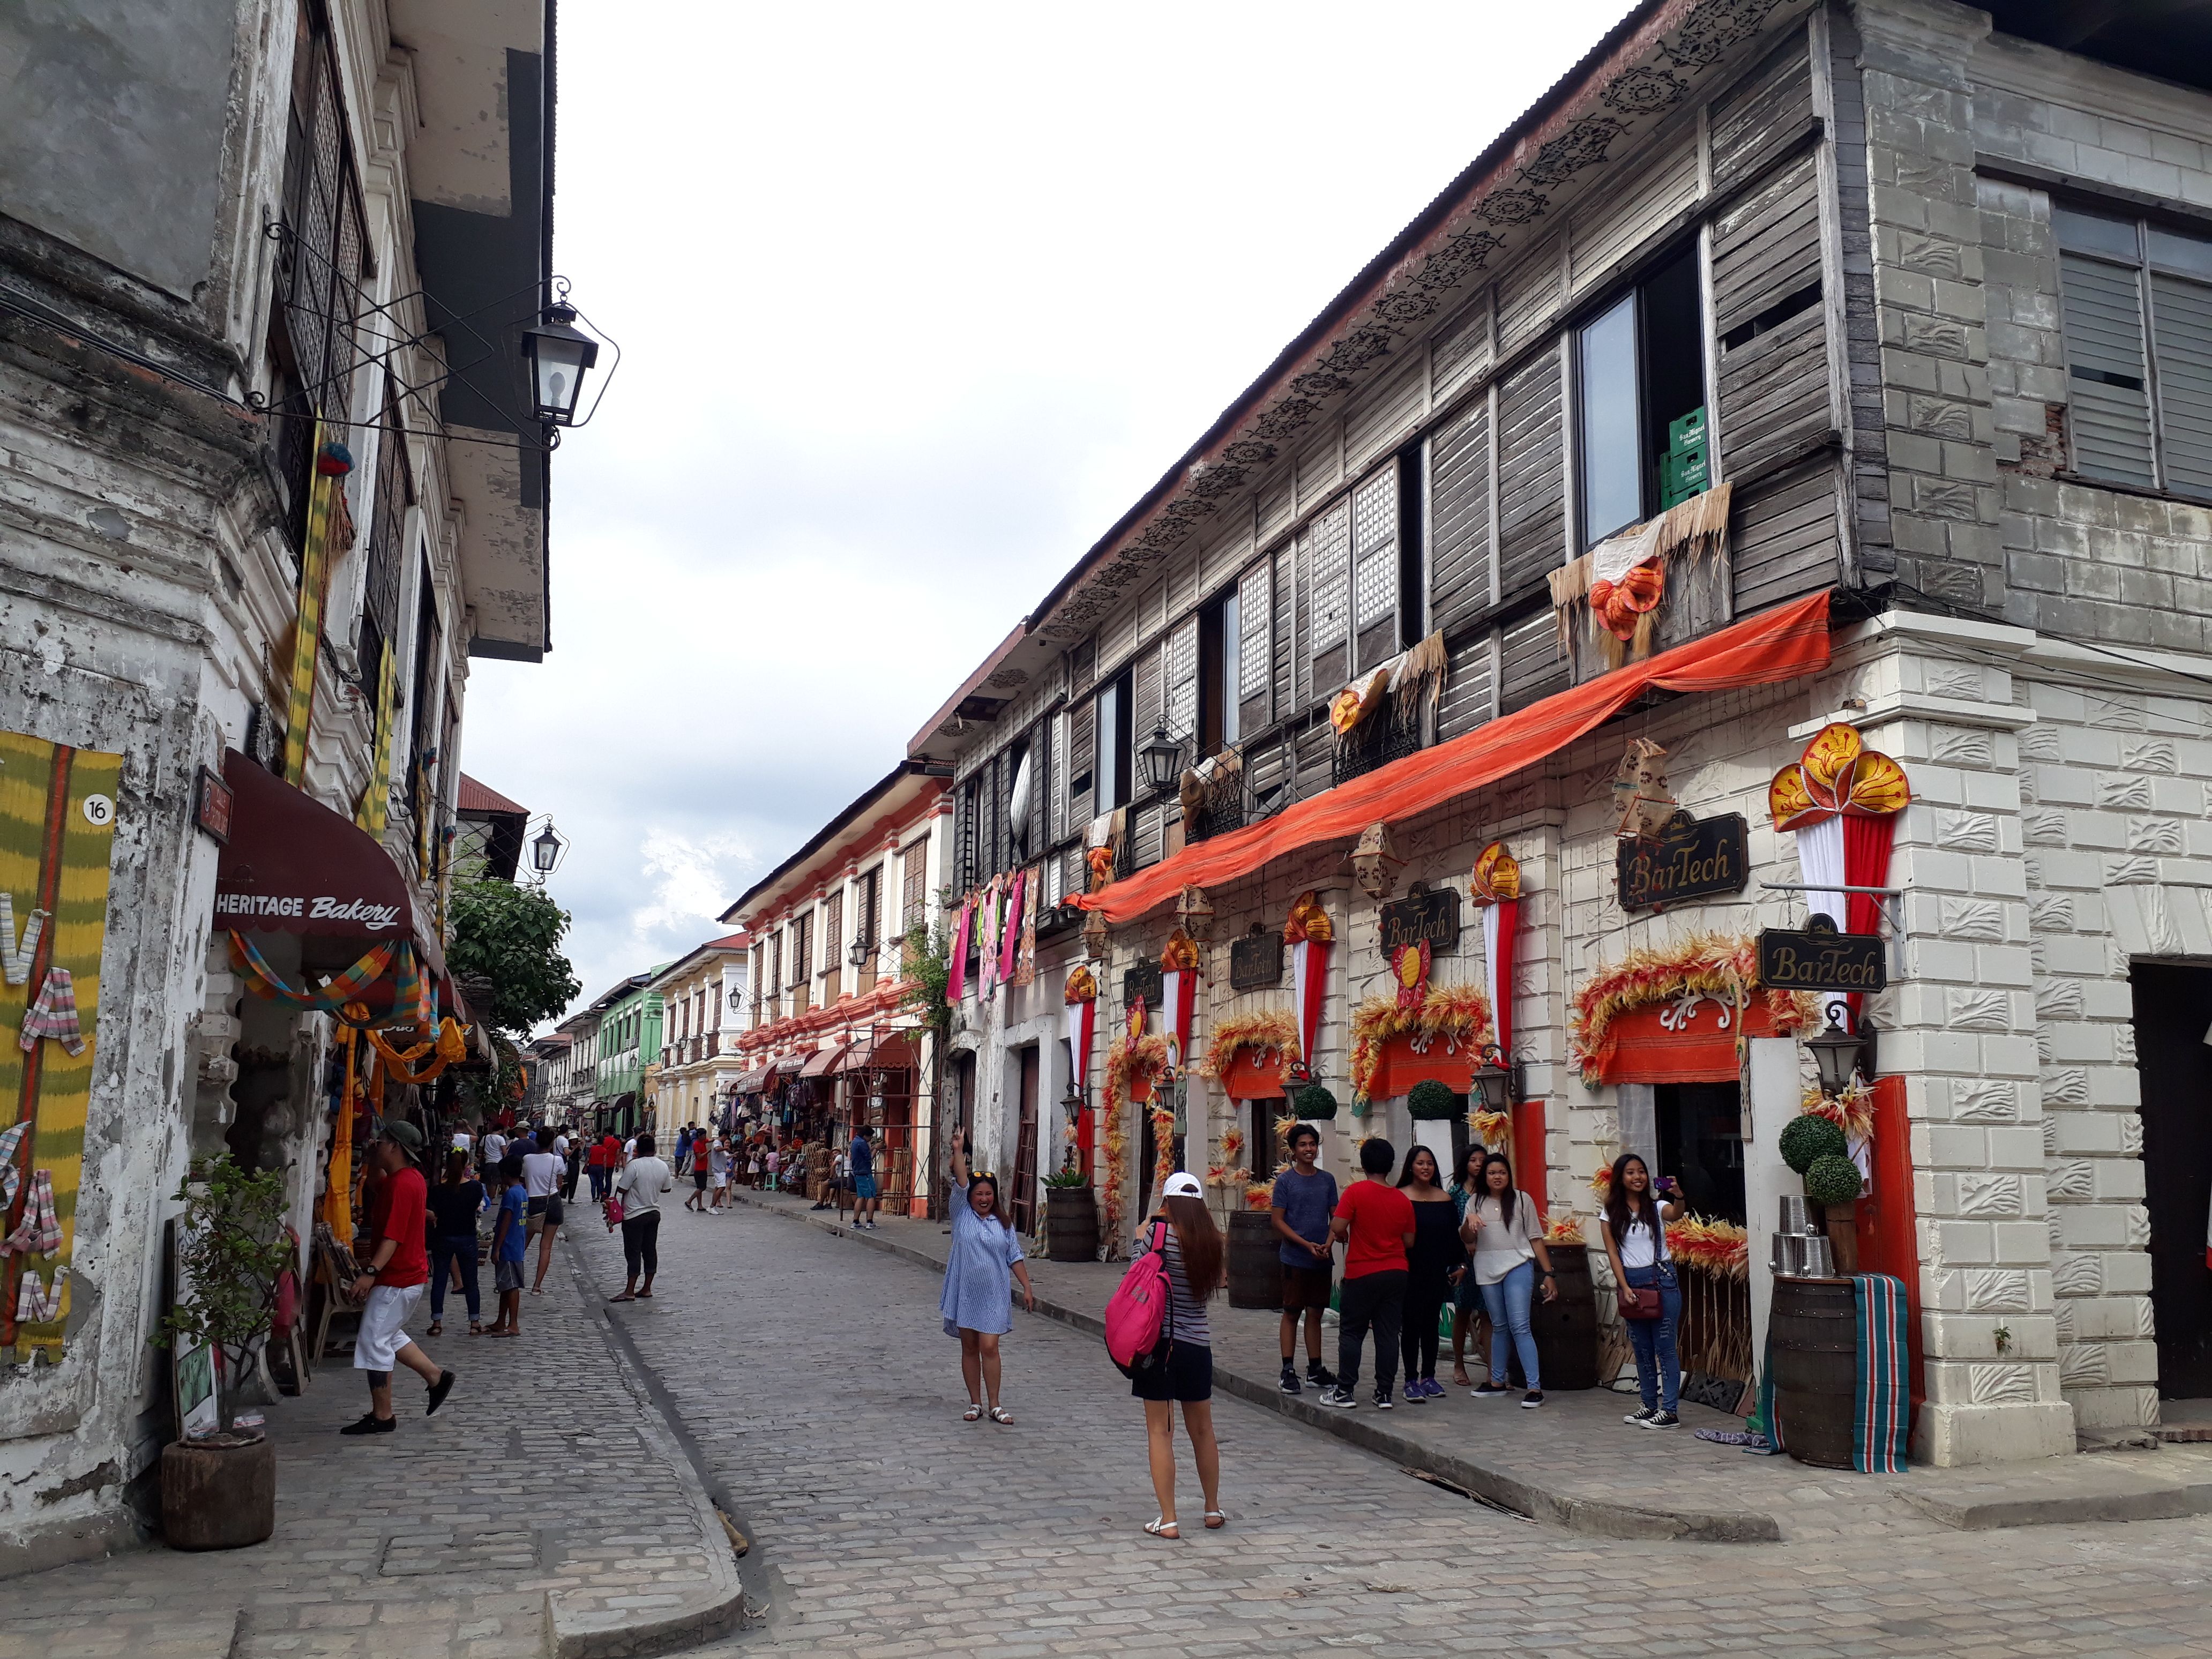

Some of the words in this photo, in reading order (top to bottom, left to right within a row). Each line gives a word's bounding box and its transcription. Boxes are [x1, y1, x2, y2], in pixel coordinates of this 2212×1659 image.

[89, 802, 106, 819] 16
[1627, 839, 1730, 895] BarTech
[216, 893, 304, 917] HERITAGE
[309, 896, 401, 931] Bakery
[1387, 907, 1446, 948] BarTech
[1771, 946, 1877, 985] BarTech
